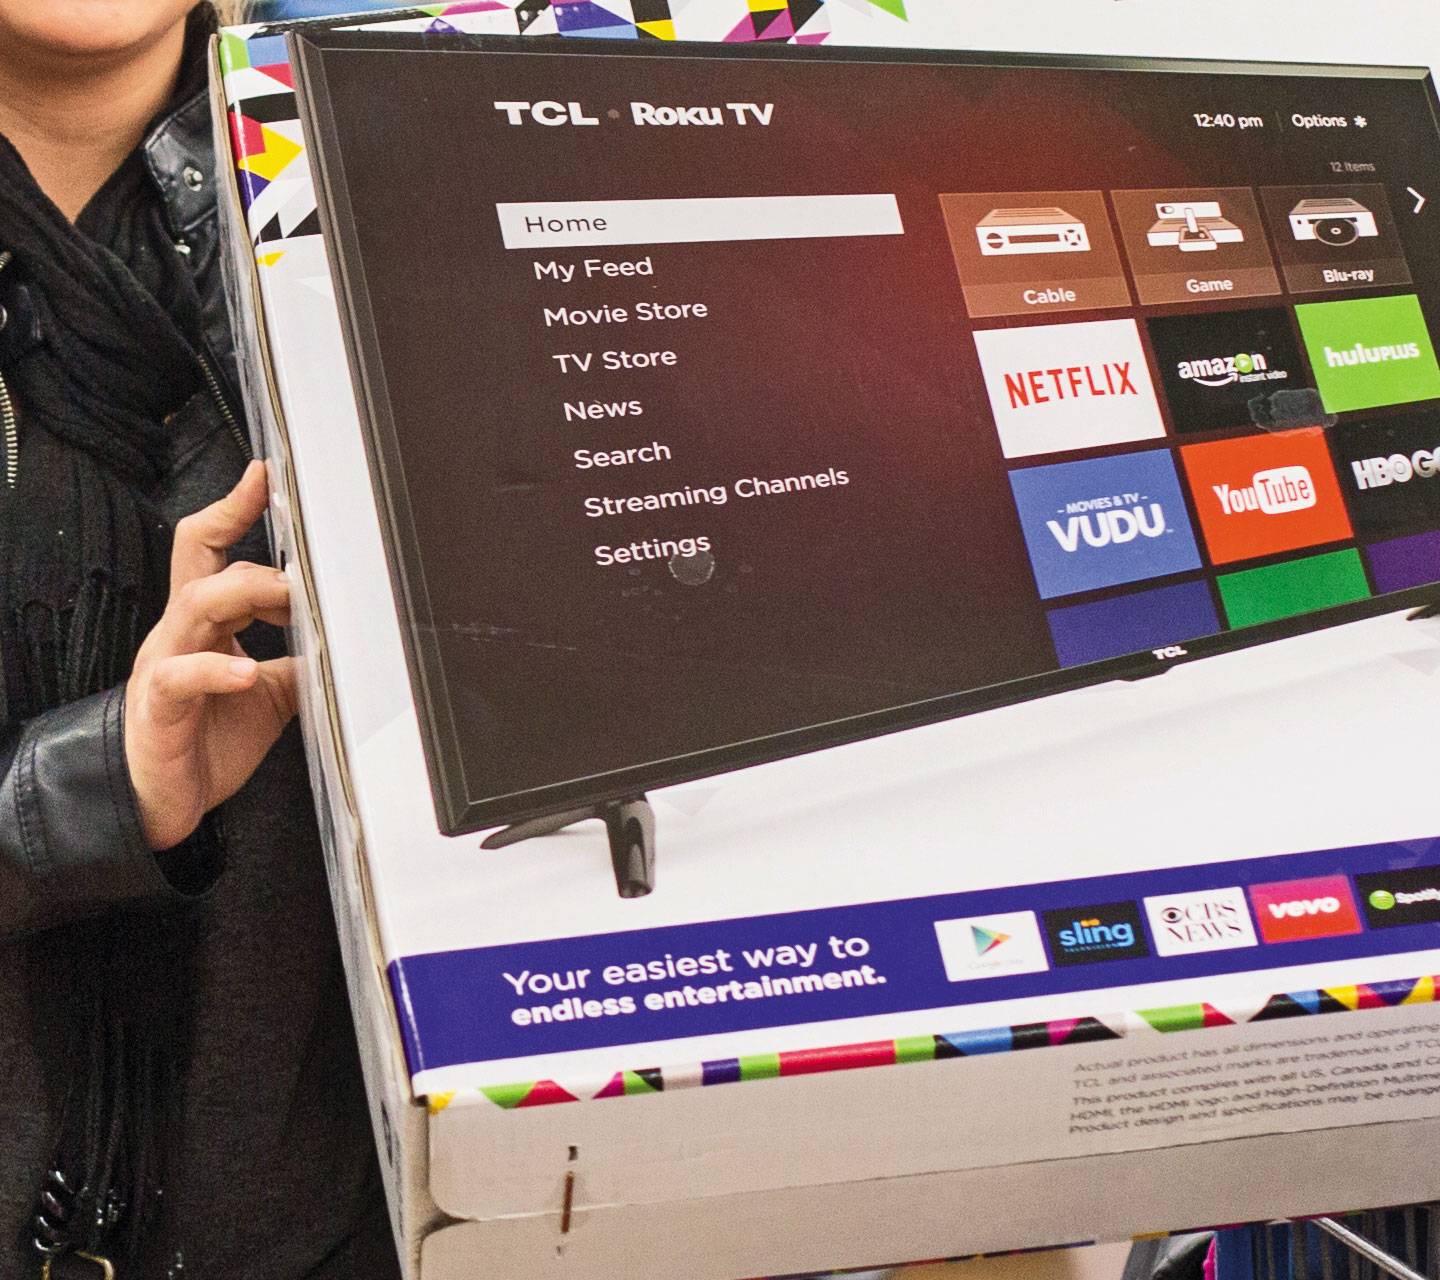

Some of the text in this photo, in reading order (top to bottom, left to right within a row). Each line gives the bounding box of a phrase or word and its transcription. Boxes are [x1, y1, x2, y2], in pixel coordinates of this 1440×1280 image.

[494, 101, 775, 126] TCL Roku TV
[1193, 113, 1348, 131] 12:40 pm Options
[525, 215, 608, 233] Home
[533, 257, 654, 283] My Feed
[1022, 266, 1375, 305] Cable Game Blu-ray
[543, 300, 709, 327] Movie Store
[552, 348, 678, 373] TV Store
[1178, 353, 1268, 381] amazon
[1003, 361, 1138, 410] NETFLIX
[563, 399, 643, 422] News
[573, 441, 672, 470] Search
[583, 466, 850, 518] Streaming Channels
[1045, 503, 1166, 554] VUDU
[593, 534, 712, 567] Settings
[1151, 644, 1188, 661] TCL
[1184, 898, 1237, 924] CBS
[1267, 894, 1340, 919] vevo
[1058, 918, 1137, 949] sling
[1166, 919, 1244, 944] NEWS
[501, 935, 870, 996] Your easiest way to
[510, 964, 887, 1026] endless entertainment.
